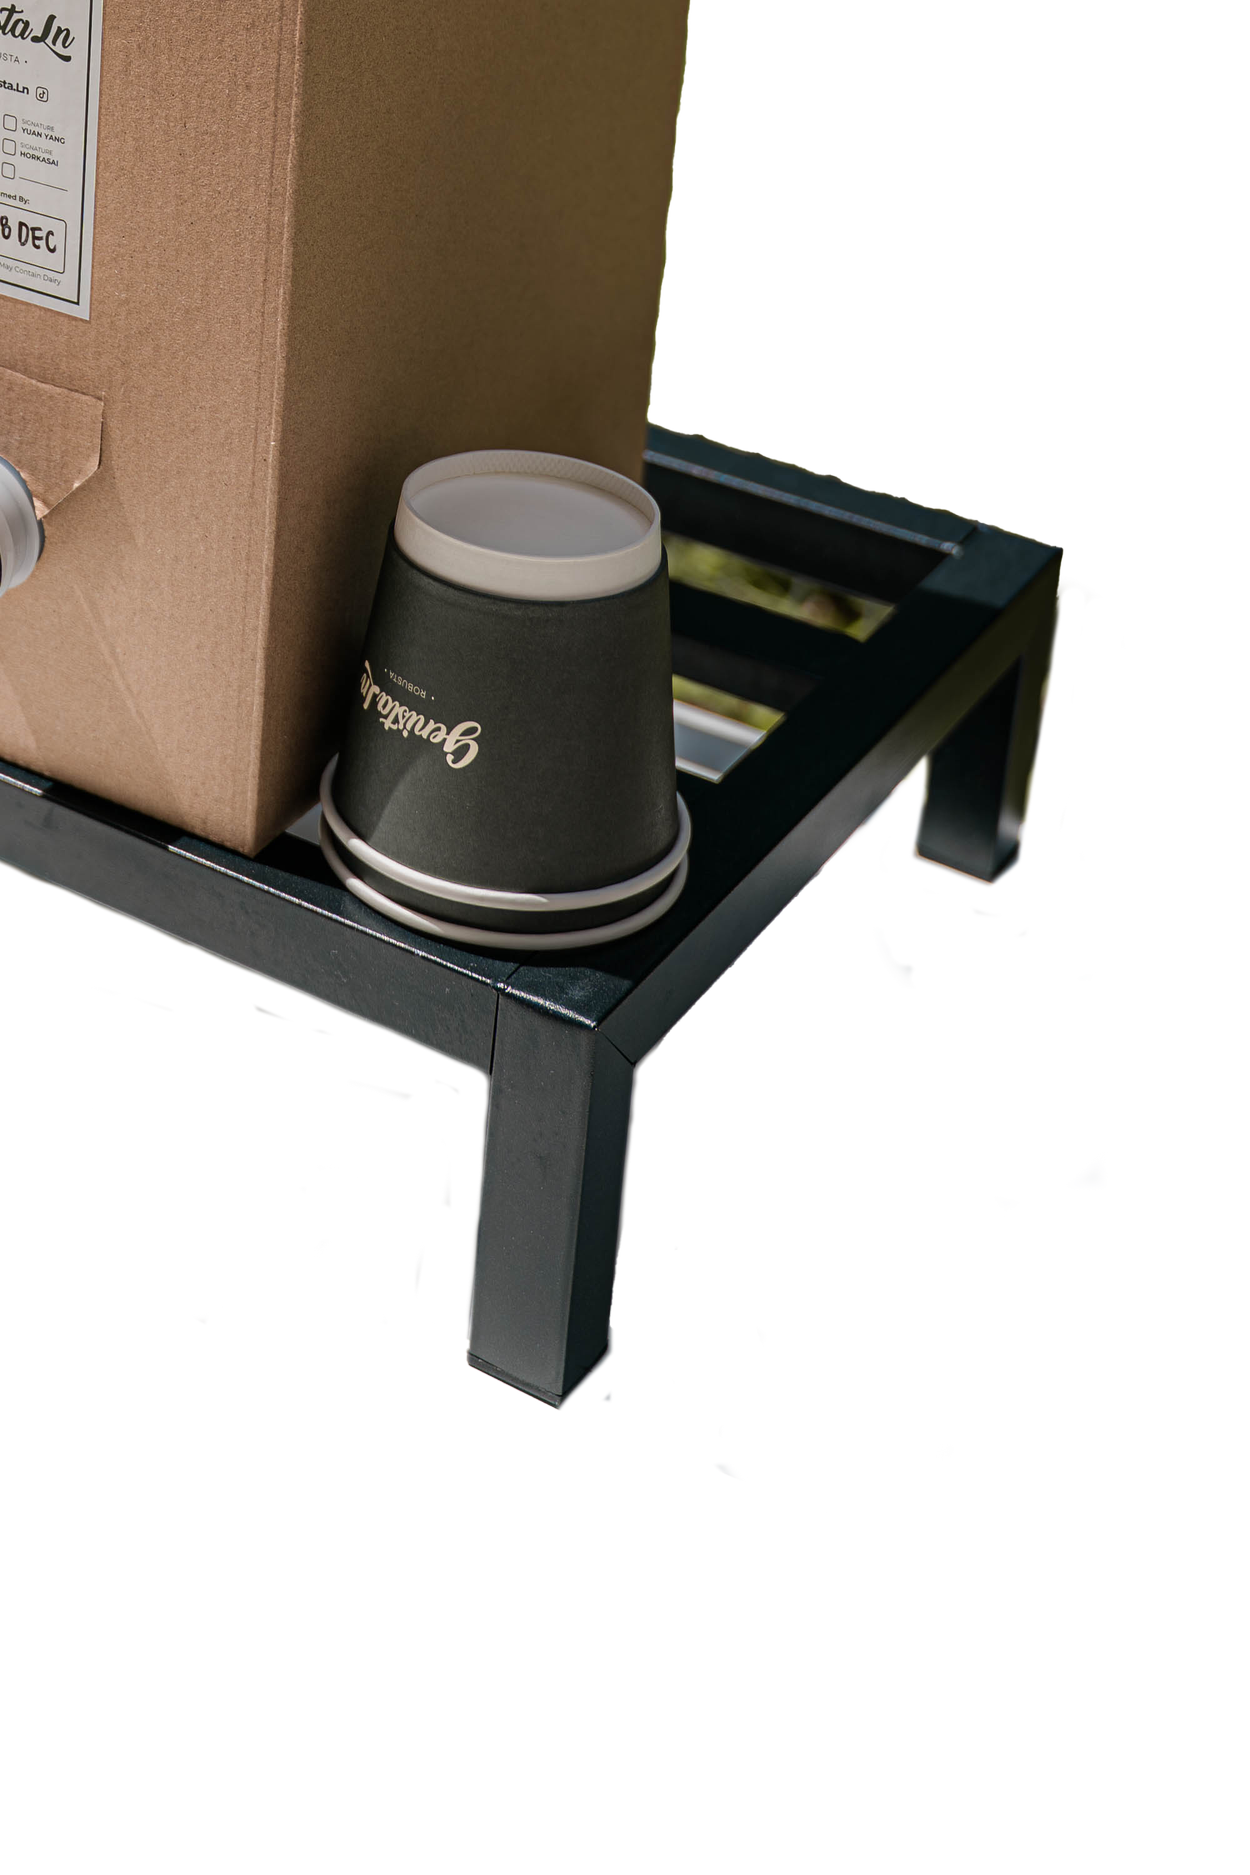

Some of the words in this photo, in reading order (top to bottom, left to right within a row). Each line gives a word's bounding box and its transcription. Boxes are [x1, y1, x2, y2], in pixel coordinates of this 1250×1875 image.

[21, 118, 55, 132] SIGNATURE
[21, 126, 43, 138] YUAN
[44, 133, 66, 144] YANG
[19, 142, 53, 156] SIGNATURE
[19, 151, 59, 167] HORKASAI
[18, 195, 30, 205] By:
[17, 220, 57, 254] DEC
[14, 265, 42, 279] Contain
[42, 274, 62, 287] Dairy
[389, 669, 427, 699] ROBUSTA
